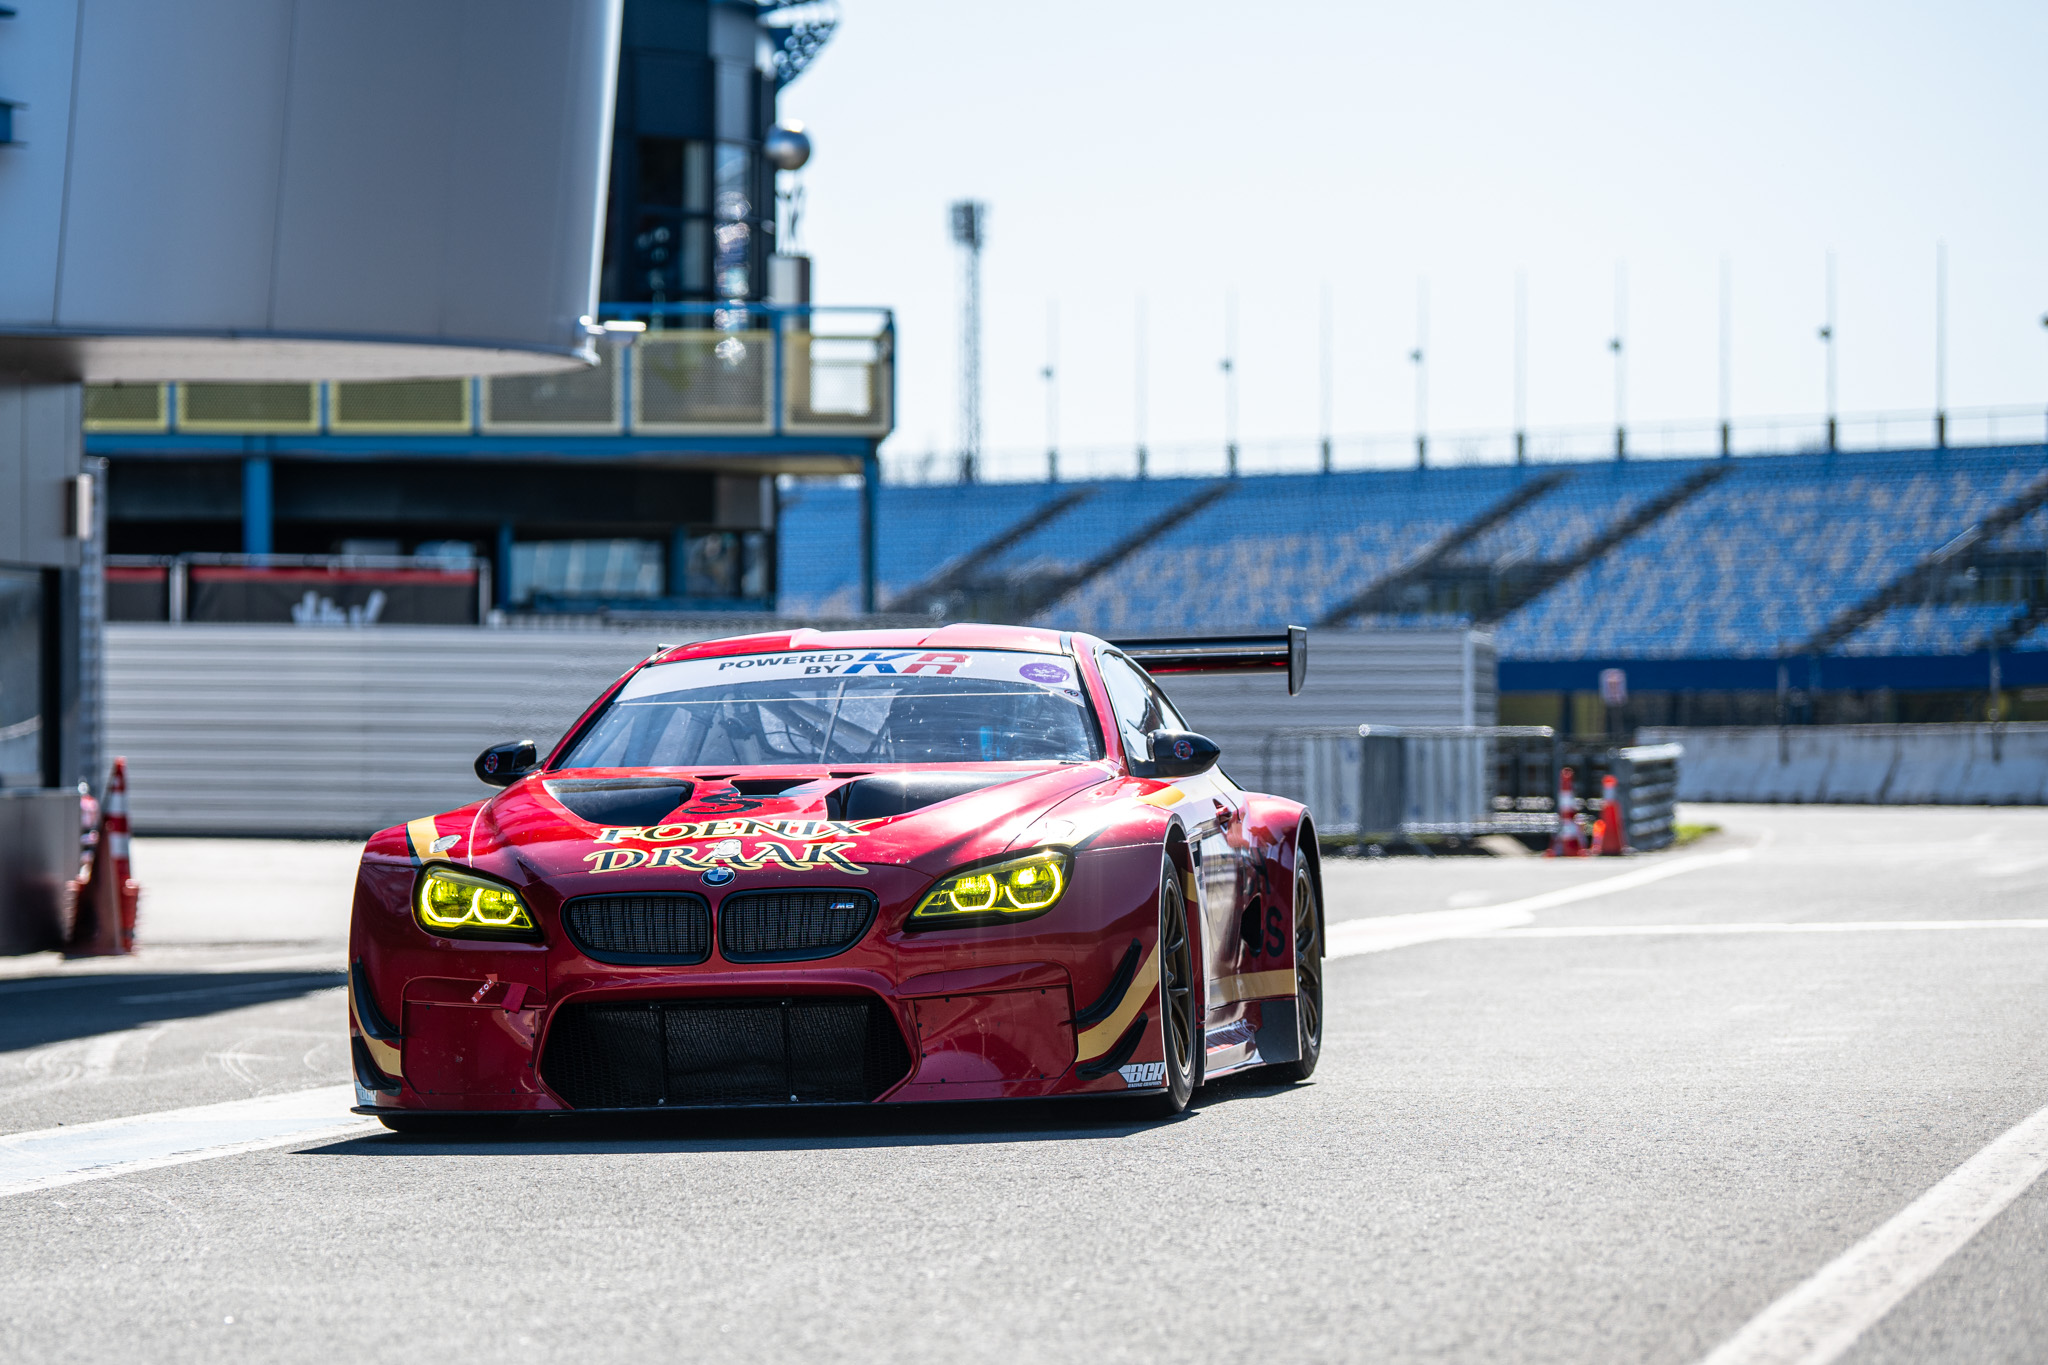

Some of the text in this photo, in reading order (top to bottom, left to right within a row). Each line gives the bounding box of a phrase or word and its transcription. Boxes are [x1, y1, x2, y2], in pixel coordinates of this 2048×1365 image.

[718, 654, 854, 671] POWERED
[804, 665, 841, 675] BY
[593, 817, 884, 842] FOENIX
[583, 842, 869, 875] DRAAK
[1128, 1062, 1166, 1083] BGR
